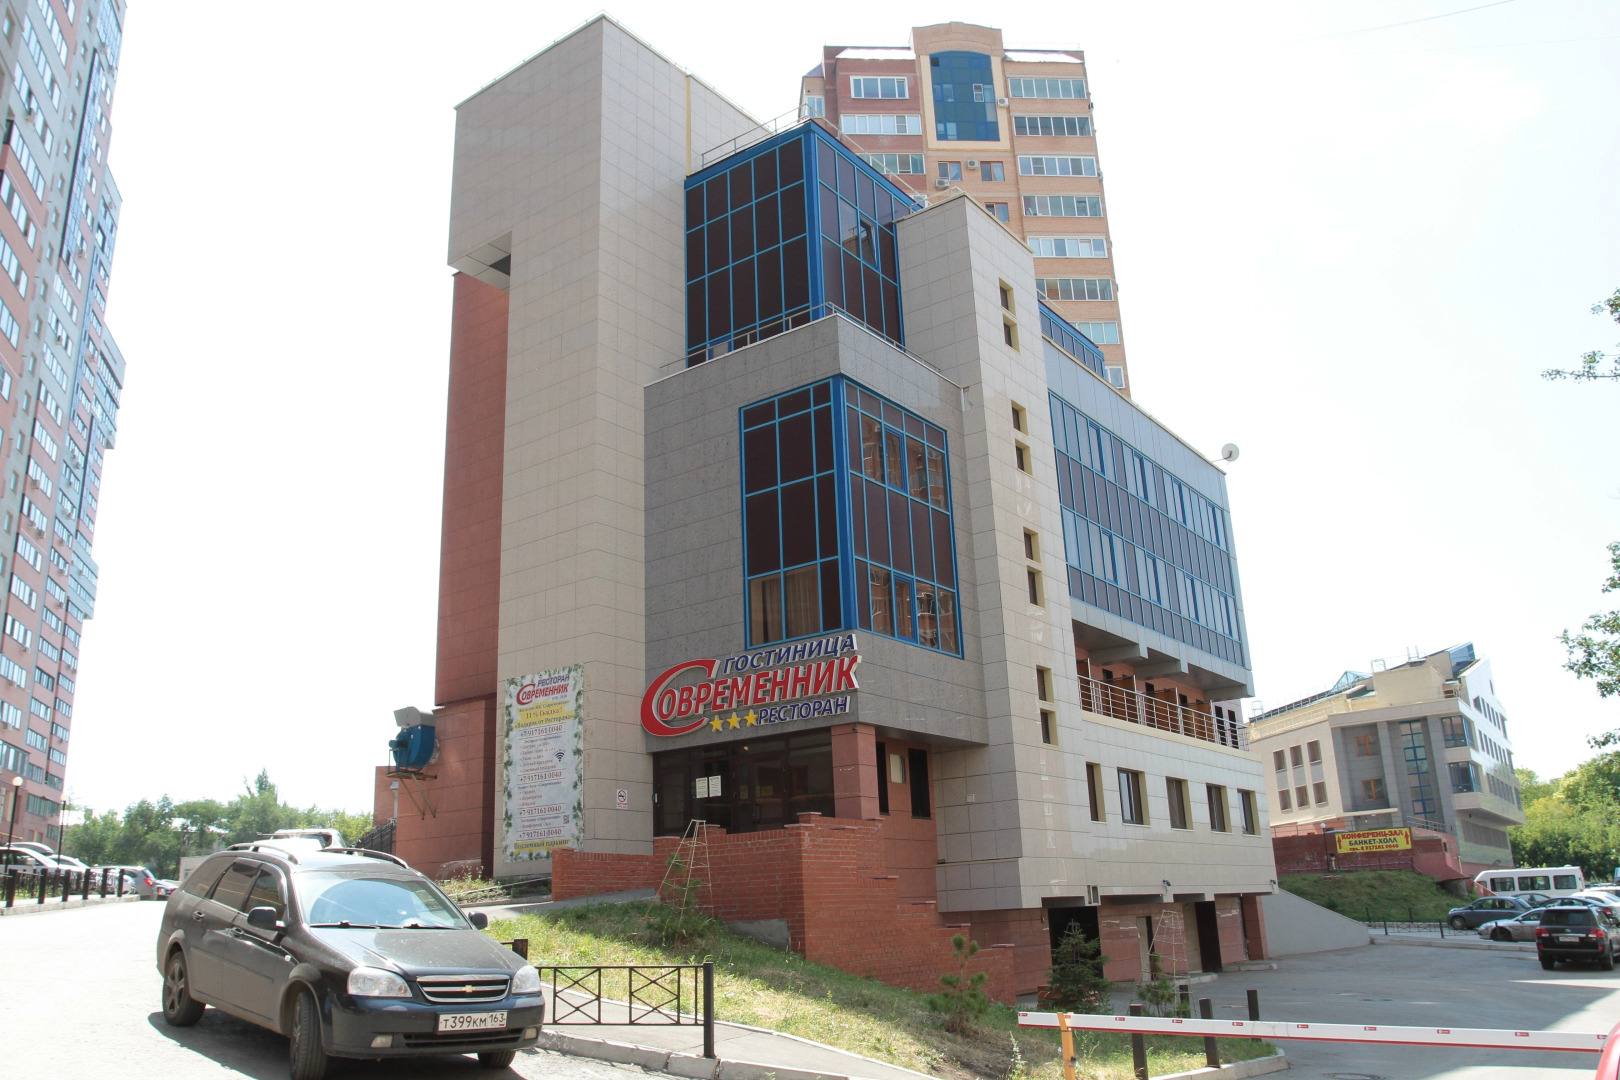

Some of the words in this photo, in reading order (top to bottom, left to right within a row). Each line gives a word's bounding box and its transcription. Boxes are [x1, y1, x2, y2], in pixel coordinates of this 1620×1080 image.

[723, 633, 857, 675] ГОСТИНИЦА
[537, 673, 570, 687] РЕСТОРАН
[516, 683, 569, 706] СОВРЕМЕННИК
[640, 655, 862, 737] СОВРЕМЕННИК
[758, 696, 850, 725] РЕСТОРАН
[1341, 830, 1404, 840] КОНФЕРЕНЦ-ЗАЛ
[1348, 837, 1398, 847] БАНКЕТ-ХОЛЛ
[443, 1015, 487, 1029] Т399КМ
[489, 1013, 505, 1023] 163
